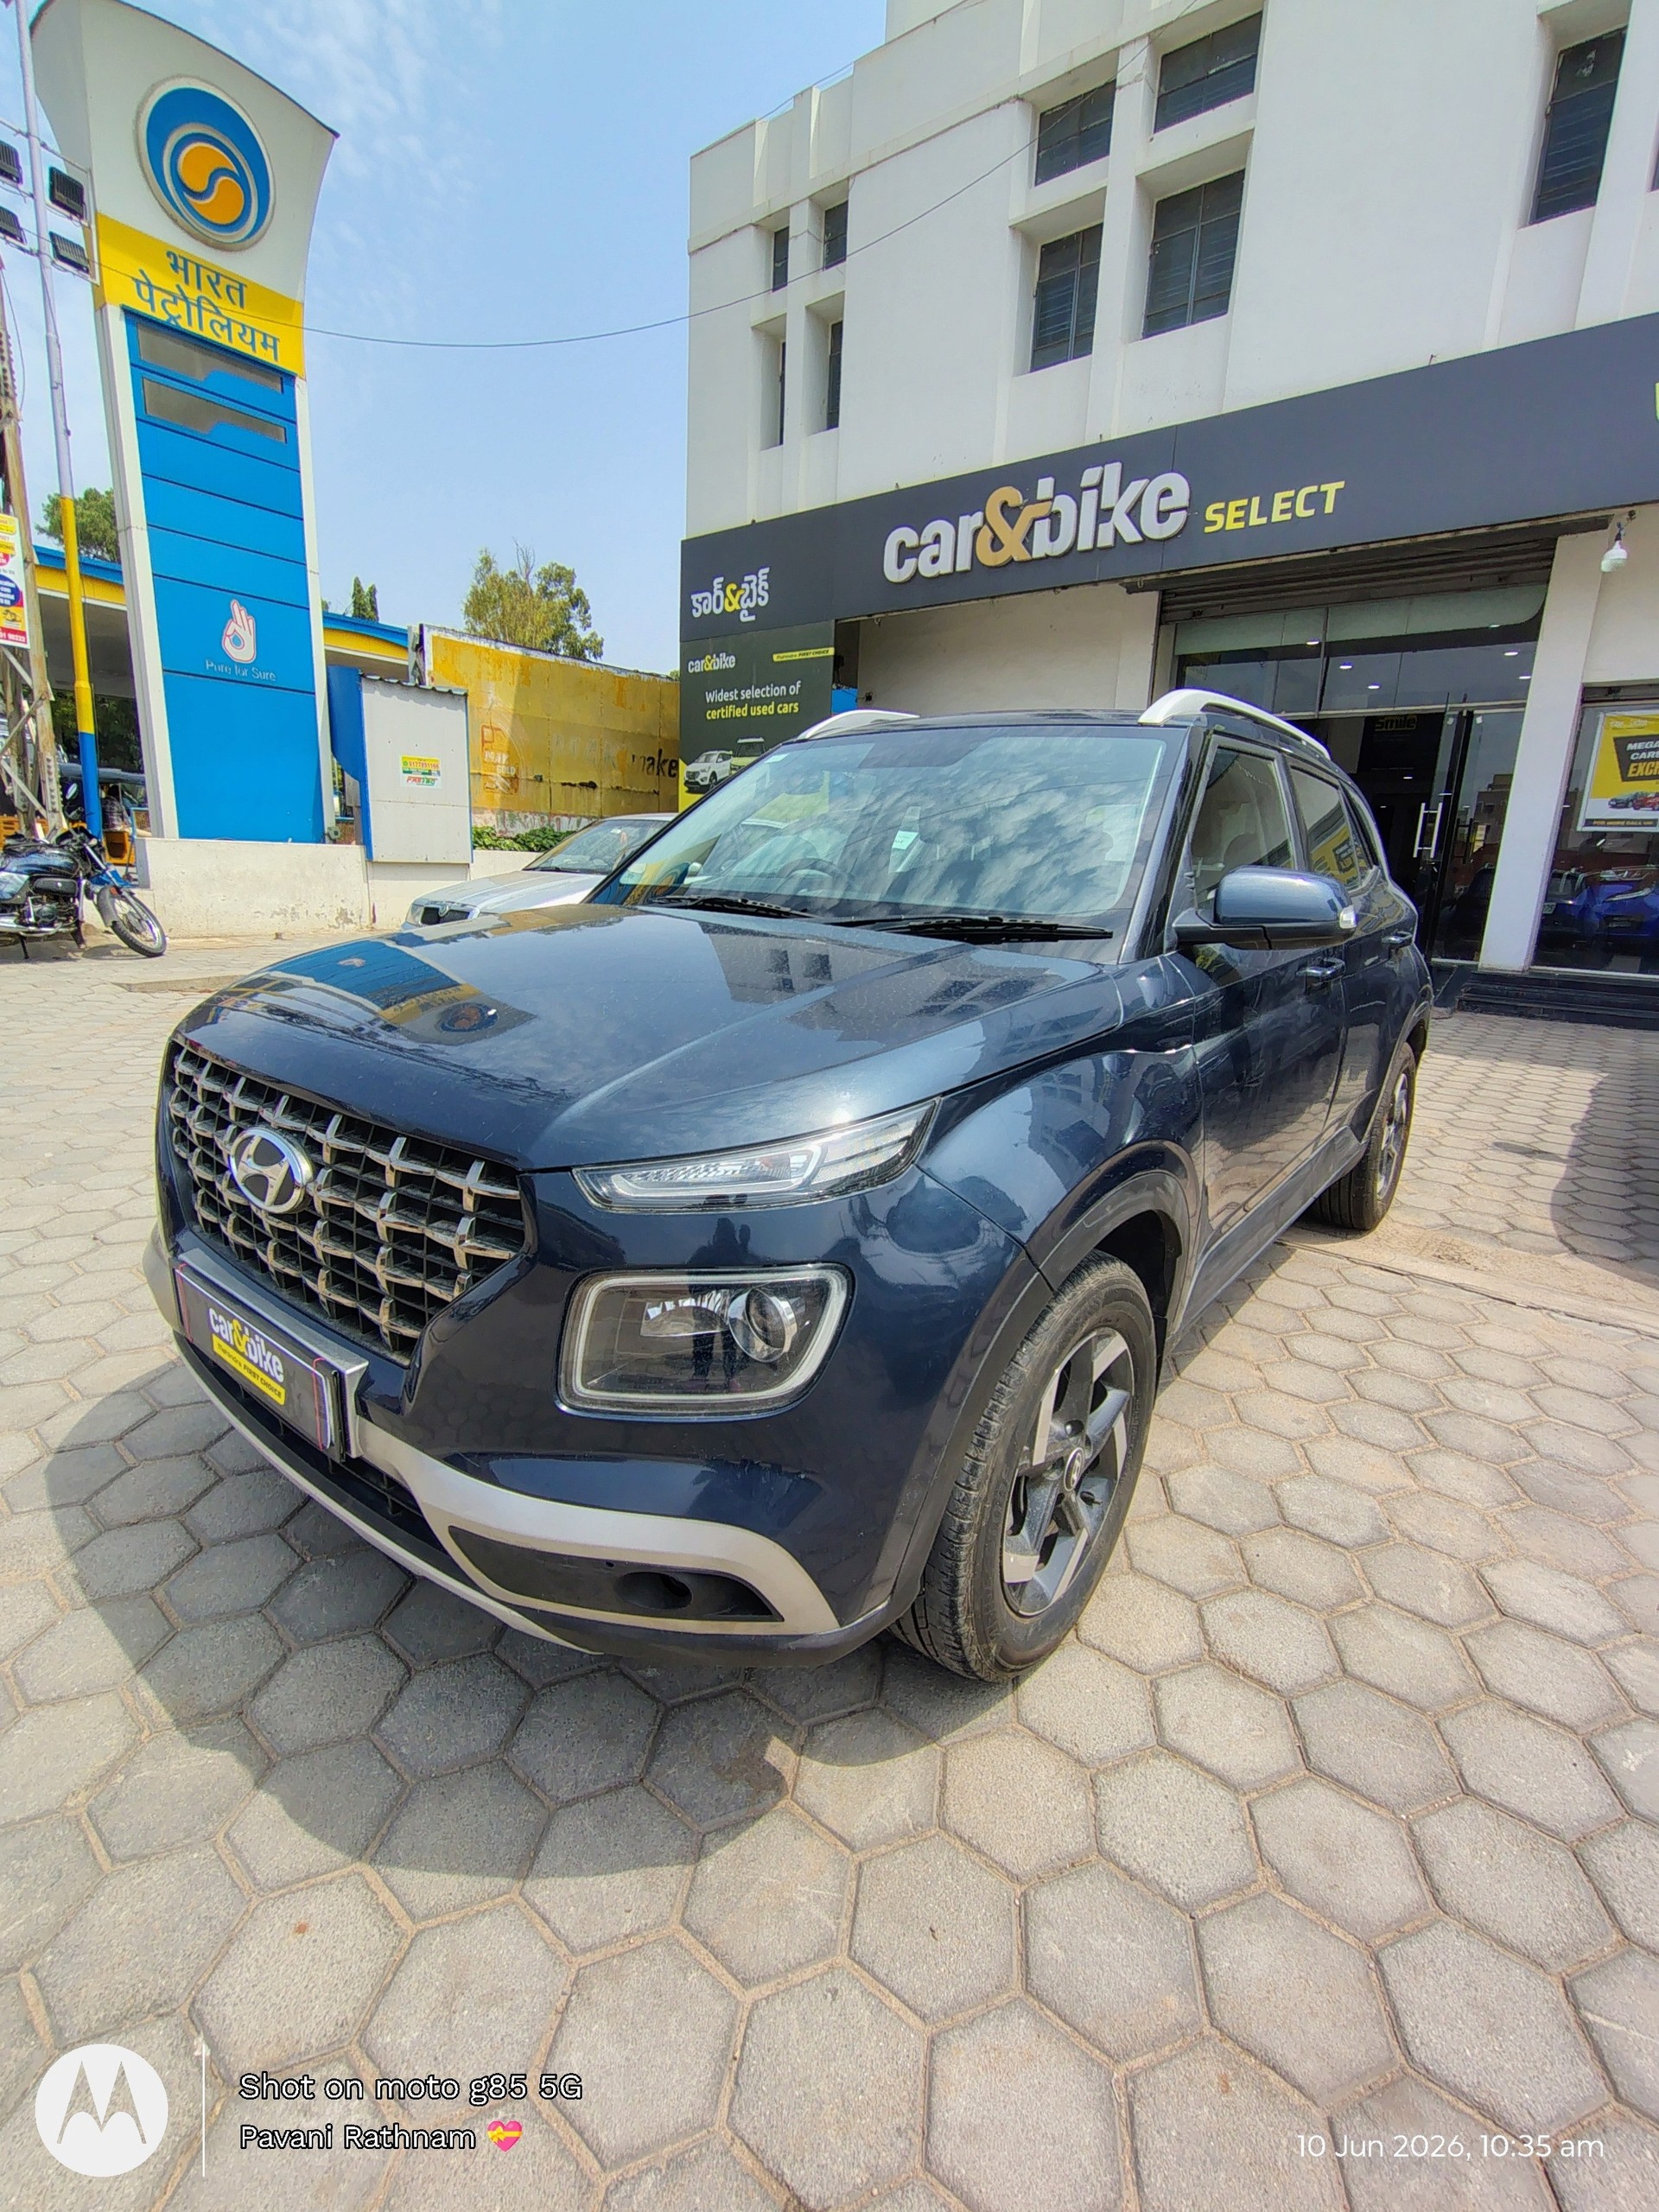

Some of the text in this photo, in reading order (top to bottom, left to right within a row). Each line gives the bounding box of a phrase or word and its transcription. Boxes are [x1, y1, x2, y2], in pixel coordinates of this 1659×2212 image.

[166, 251, 247, 309] भारत
[132, 269, 280, 362] पेट्रोलियम
[883, 461, 1345, 584] car&bike SELECT
[690, 567, 770, 622] కార్&బైక్
[206, 659, 276, 681] Pure for Sure
[688, 652, 735, 673] car&bike
[705, 680, 802, 703] Widest selection of
[706, 701, 799, 721] certified used cars
[209, 1307, 284, 1382] car&bike
[243, 1364, 260, 1381] FIRST
[260, 1377, 283, 1399] CHOICE
